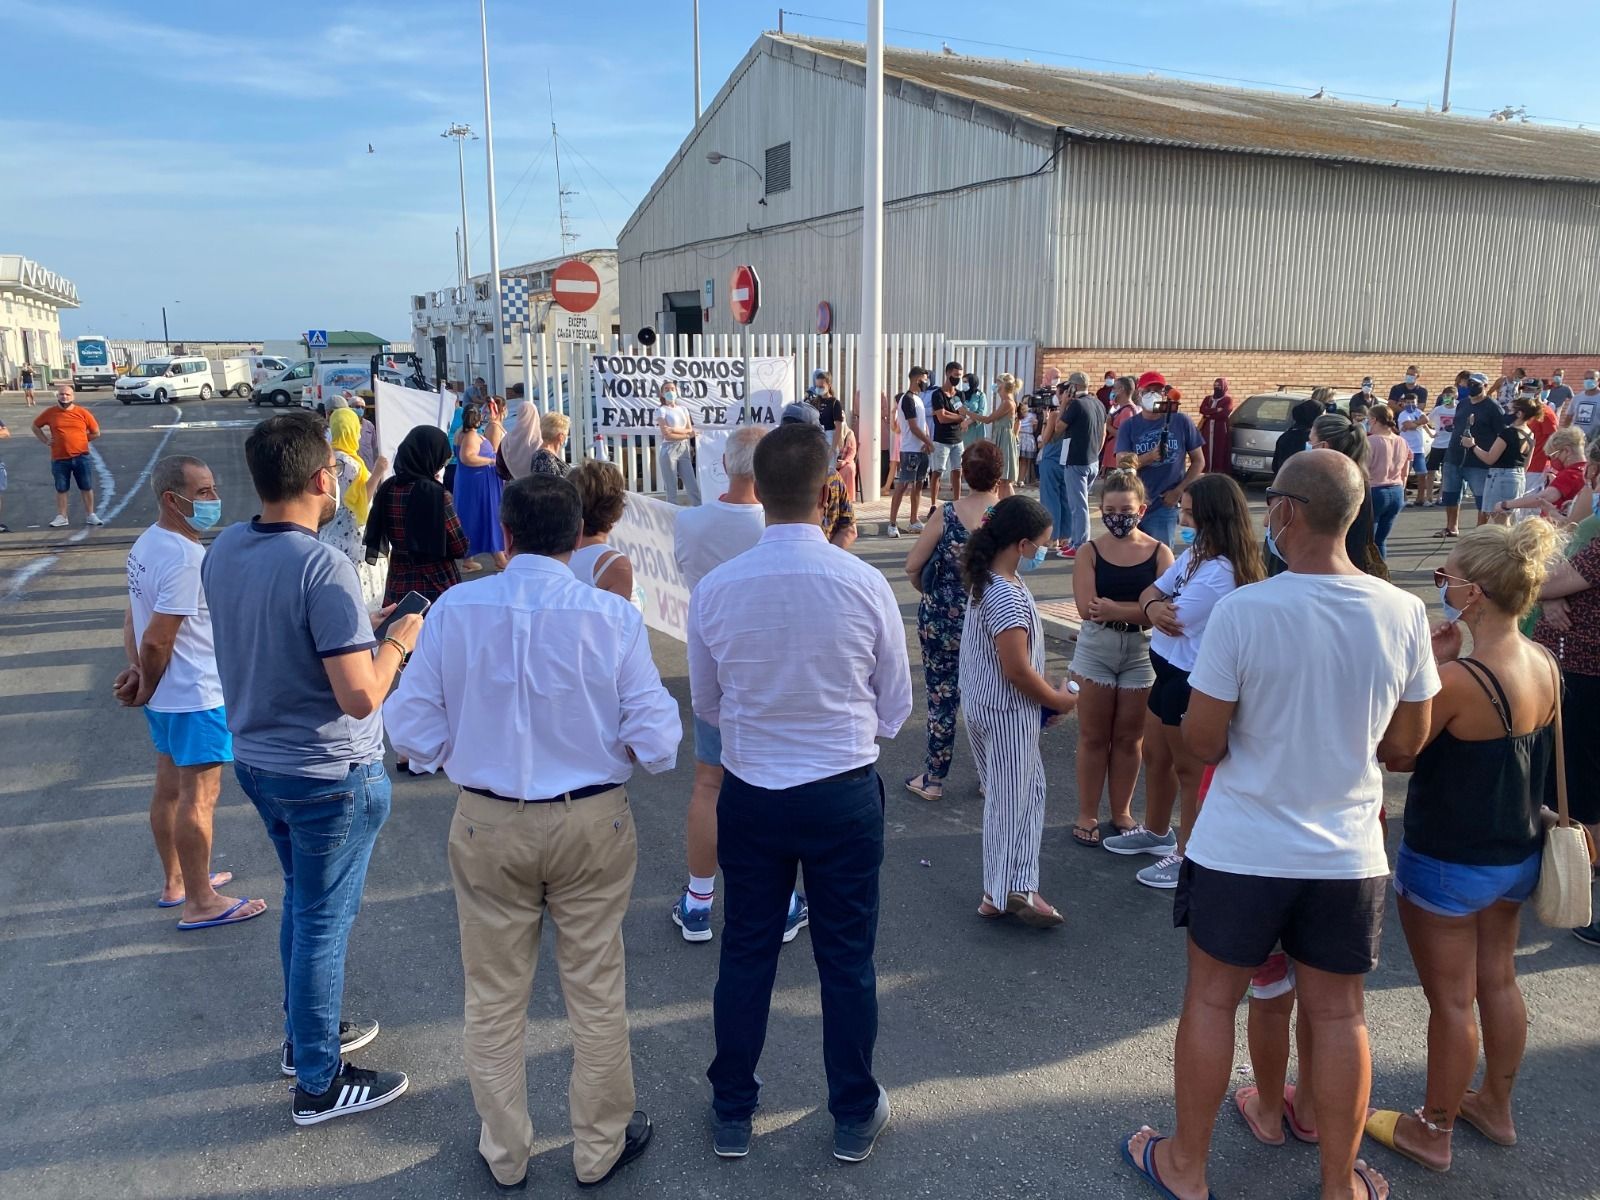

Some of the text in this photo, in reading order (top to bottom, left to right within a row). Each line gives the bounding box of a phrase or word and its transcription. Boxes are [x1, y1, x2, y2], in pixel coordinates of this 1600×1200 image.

[568, 317, 587, 328] EXCEPTO
[593, 356, 745, 378] TODOS SOMOS
[602, 379, 745, 400] MOHAED TU
[701, 406, 728, 424] TE
[1136, 442, 1157, 455] POLO
